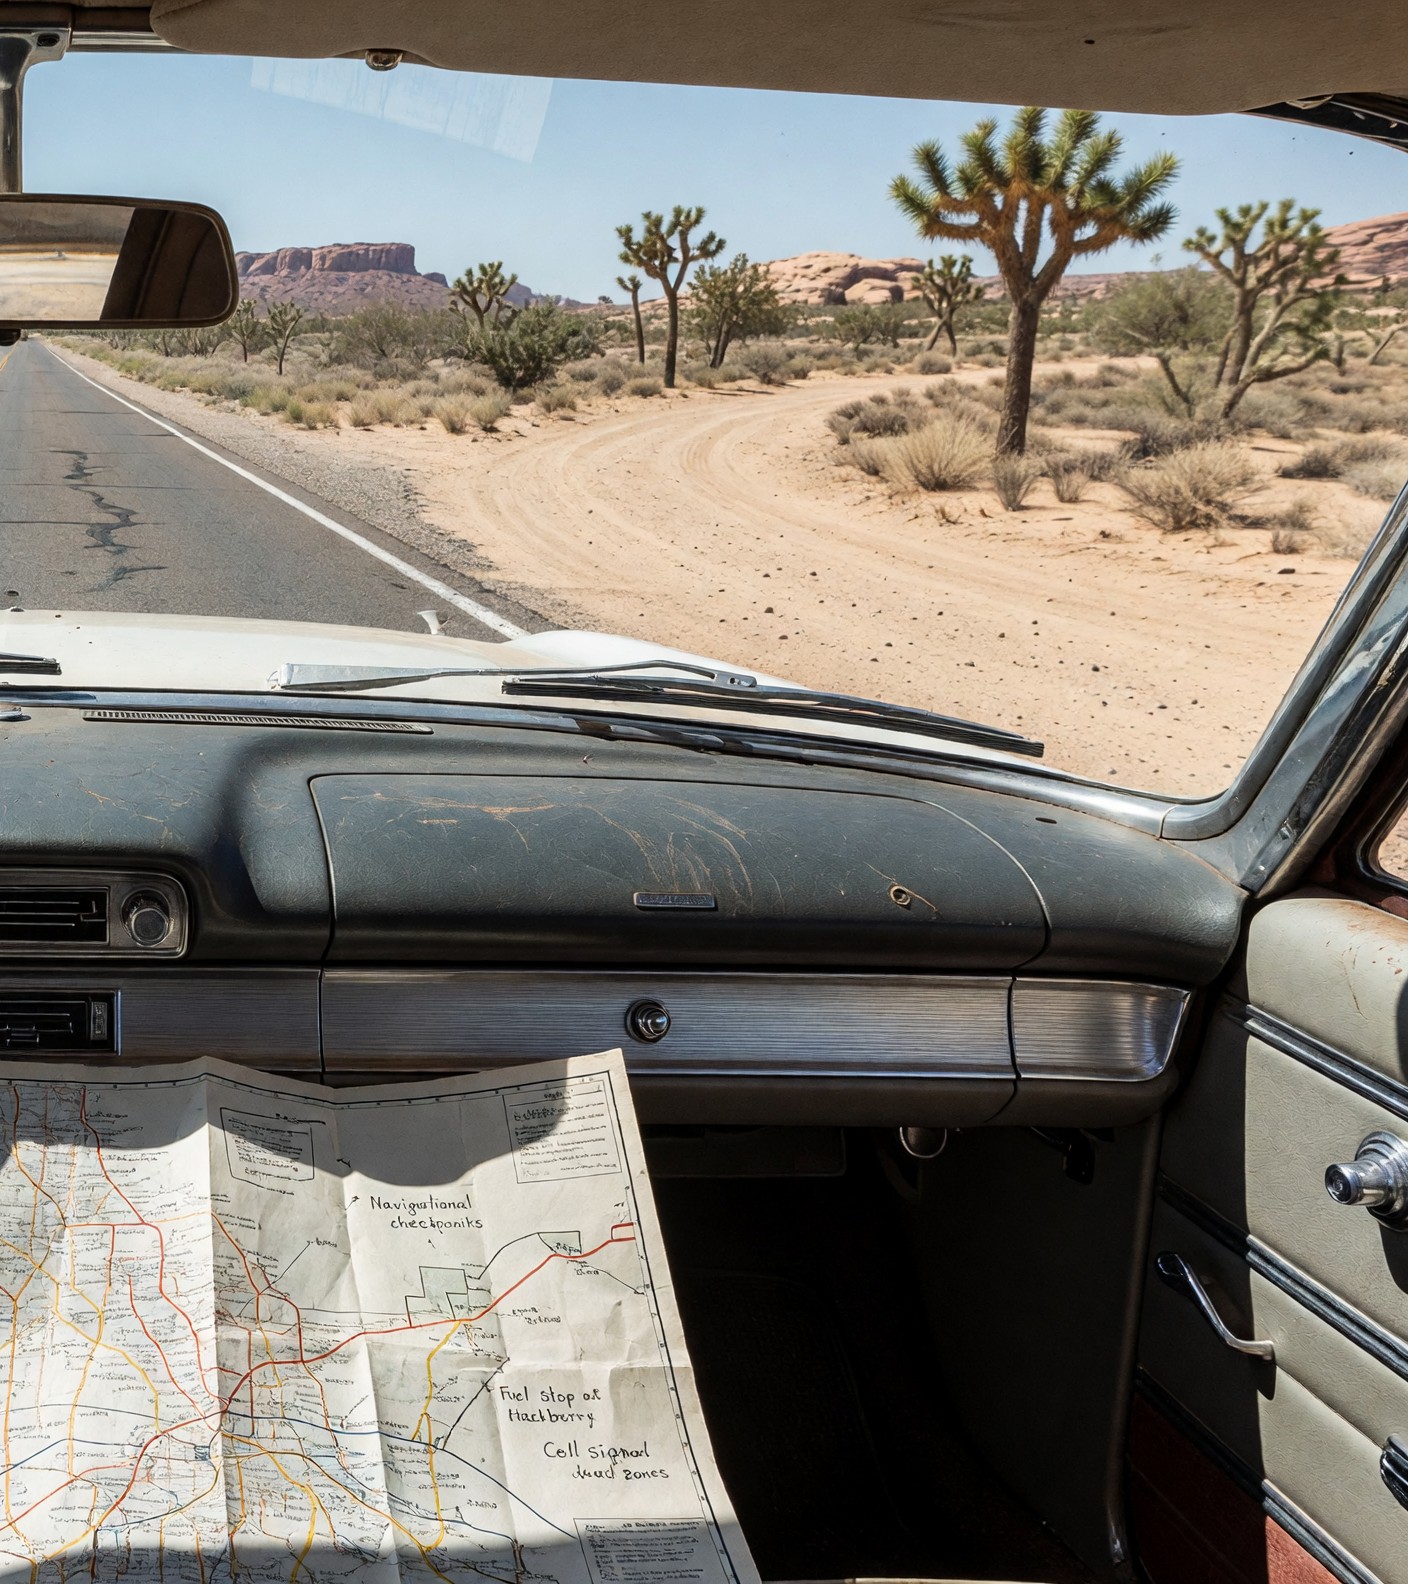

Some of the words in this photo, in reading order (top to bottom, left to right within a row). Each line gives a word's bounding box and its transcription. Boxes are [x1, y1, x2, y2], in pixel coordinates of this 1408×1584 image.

[499, 1386, 529, 1402] Fuel
[540, 1386, 575, 1409] stop
[508, 1408, 597, 1429] Hackberry
[543, 1439, 580, 1458] Cell
[622, 1468, 670, 1481] zones
